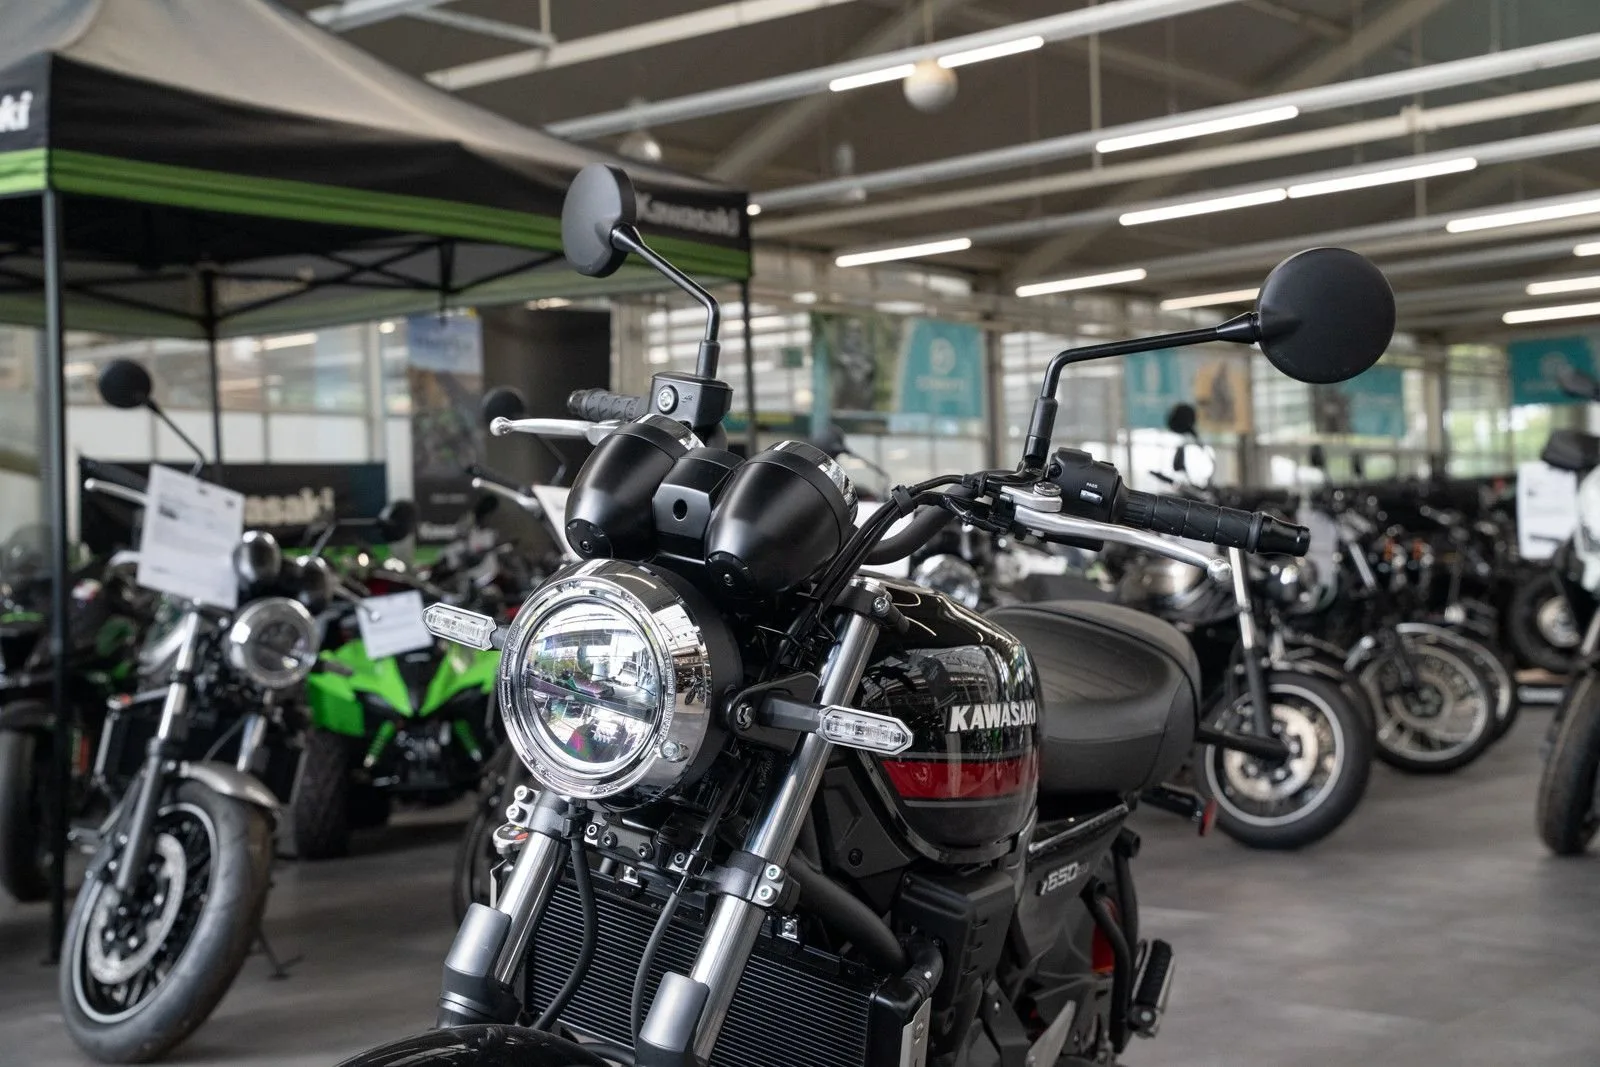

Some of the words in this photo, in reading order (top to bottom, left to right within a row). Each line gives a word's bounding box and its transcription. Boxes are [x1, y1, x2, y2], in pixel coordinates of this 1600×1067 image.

[0, 91, 33, 132] ki
[244, 487, 335, 526] asaki
[949, 701, 1036, 732] KAWASAKI
